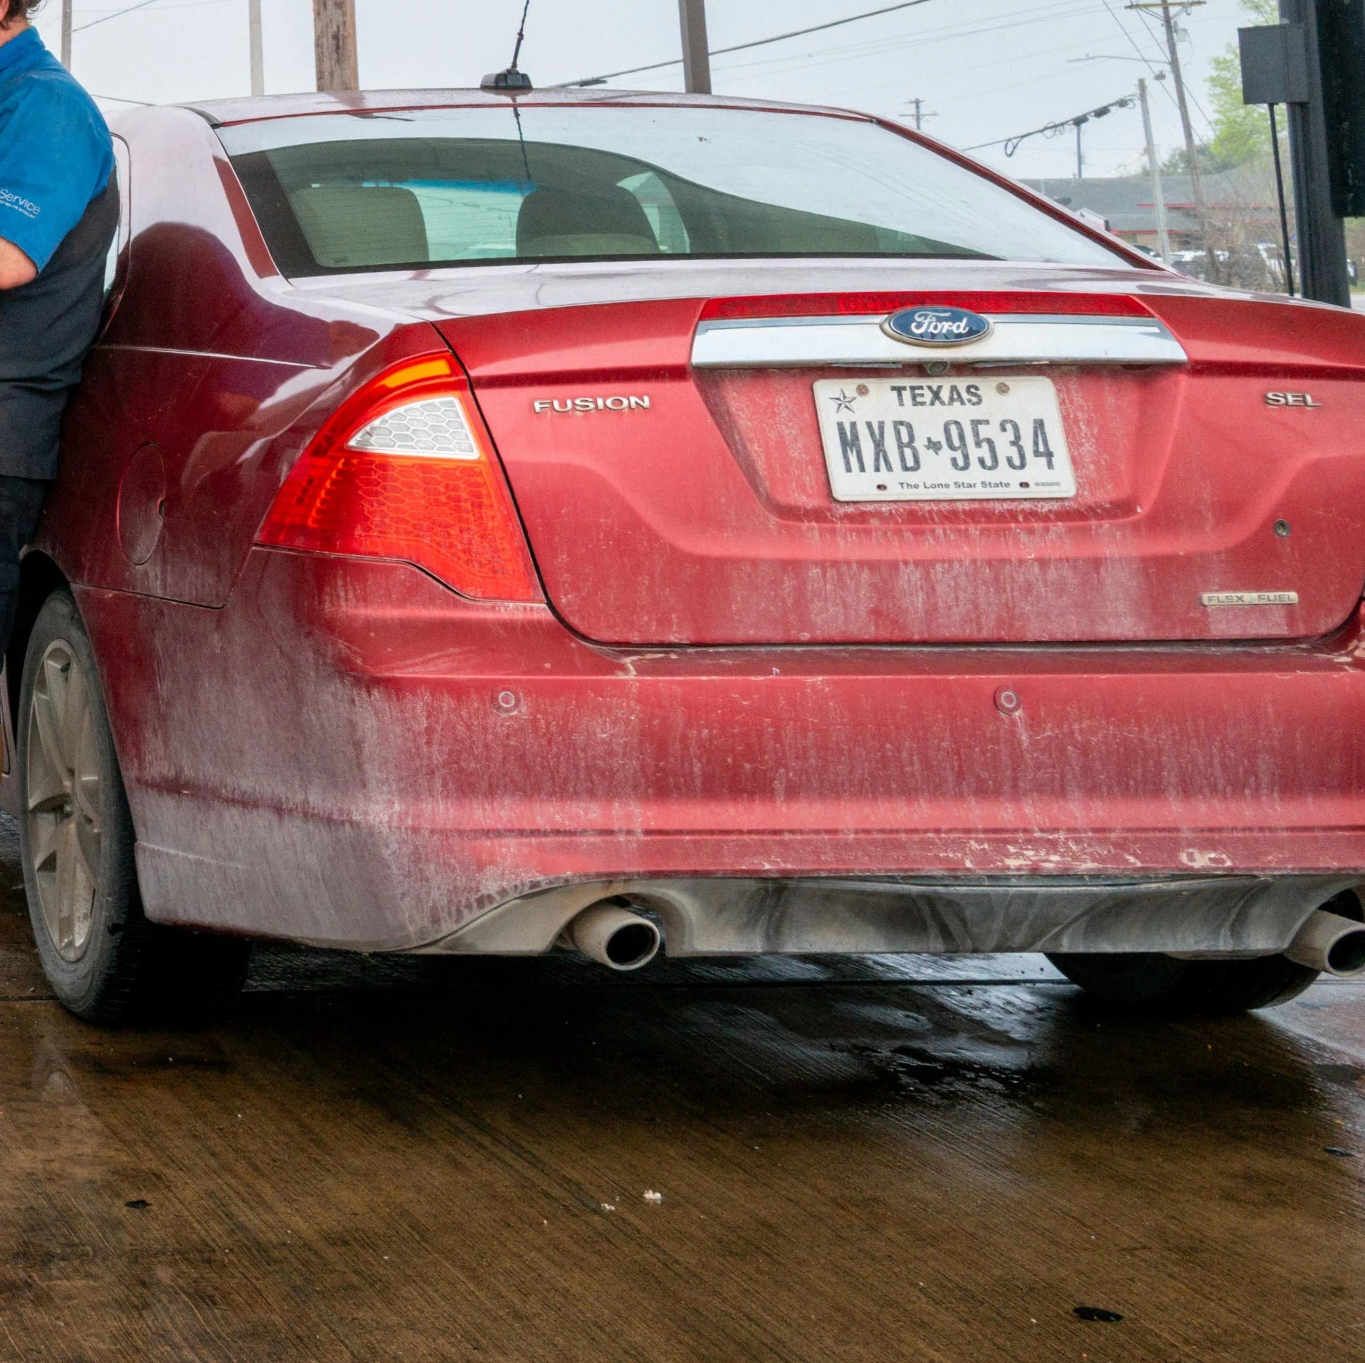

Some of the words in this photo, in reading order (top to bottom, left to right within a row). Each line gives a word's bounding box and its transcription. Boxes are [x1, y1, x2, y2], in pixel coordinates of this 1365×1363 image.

[911, 311, 969, 334] Ford
[533, 395, 650, 413] FUSION
[890, 384, 984, 407] TEXAS
[1265, 391, 1323, 407] SEL
[899, 482, 919, 490] The
[923, 481, 951, 489] Lone
[954, 481, 977, 489] Star
[981, 480, 1011, 489] State
[1207, 595, 1245, 604] FLEX
[1257, 593, 1297, 603] FUEL
